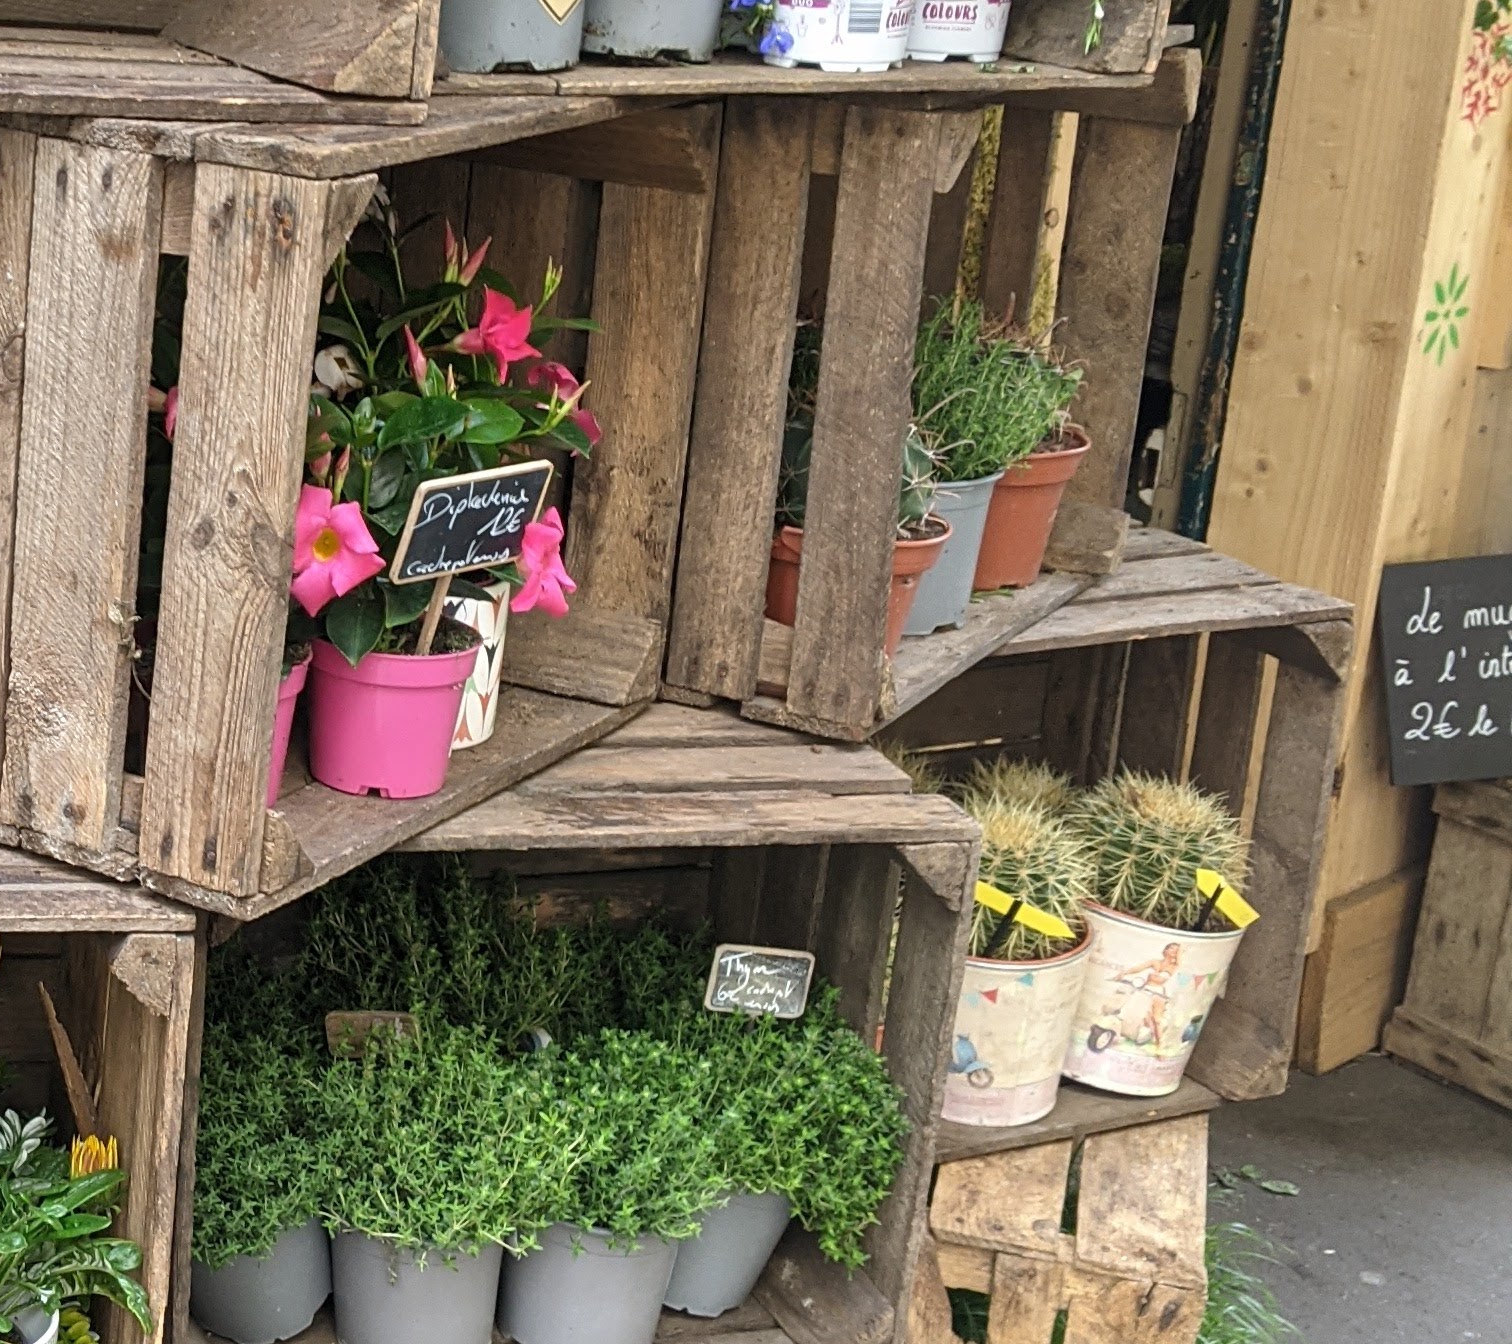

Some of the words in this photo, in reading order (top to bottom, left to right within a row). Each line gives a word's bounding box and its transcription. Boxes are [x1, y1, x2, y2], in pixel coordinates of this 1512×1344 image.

[922, 2, 979, 21] COLOURS
[1406, 585, 1444, 635] de
[1404, 701, 1462, 741] 2€
[1468, 704, 1500, 737] le
